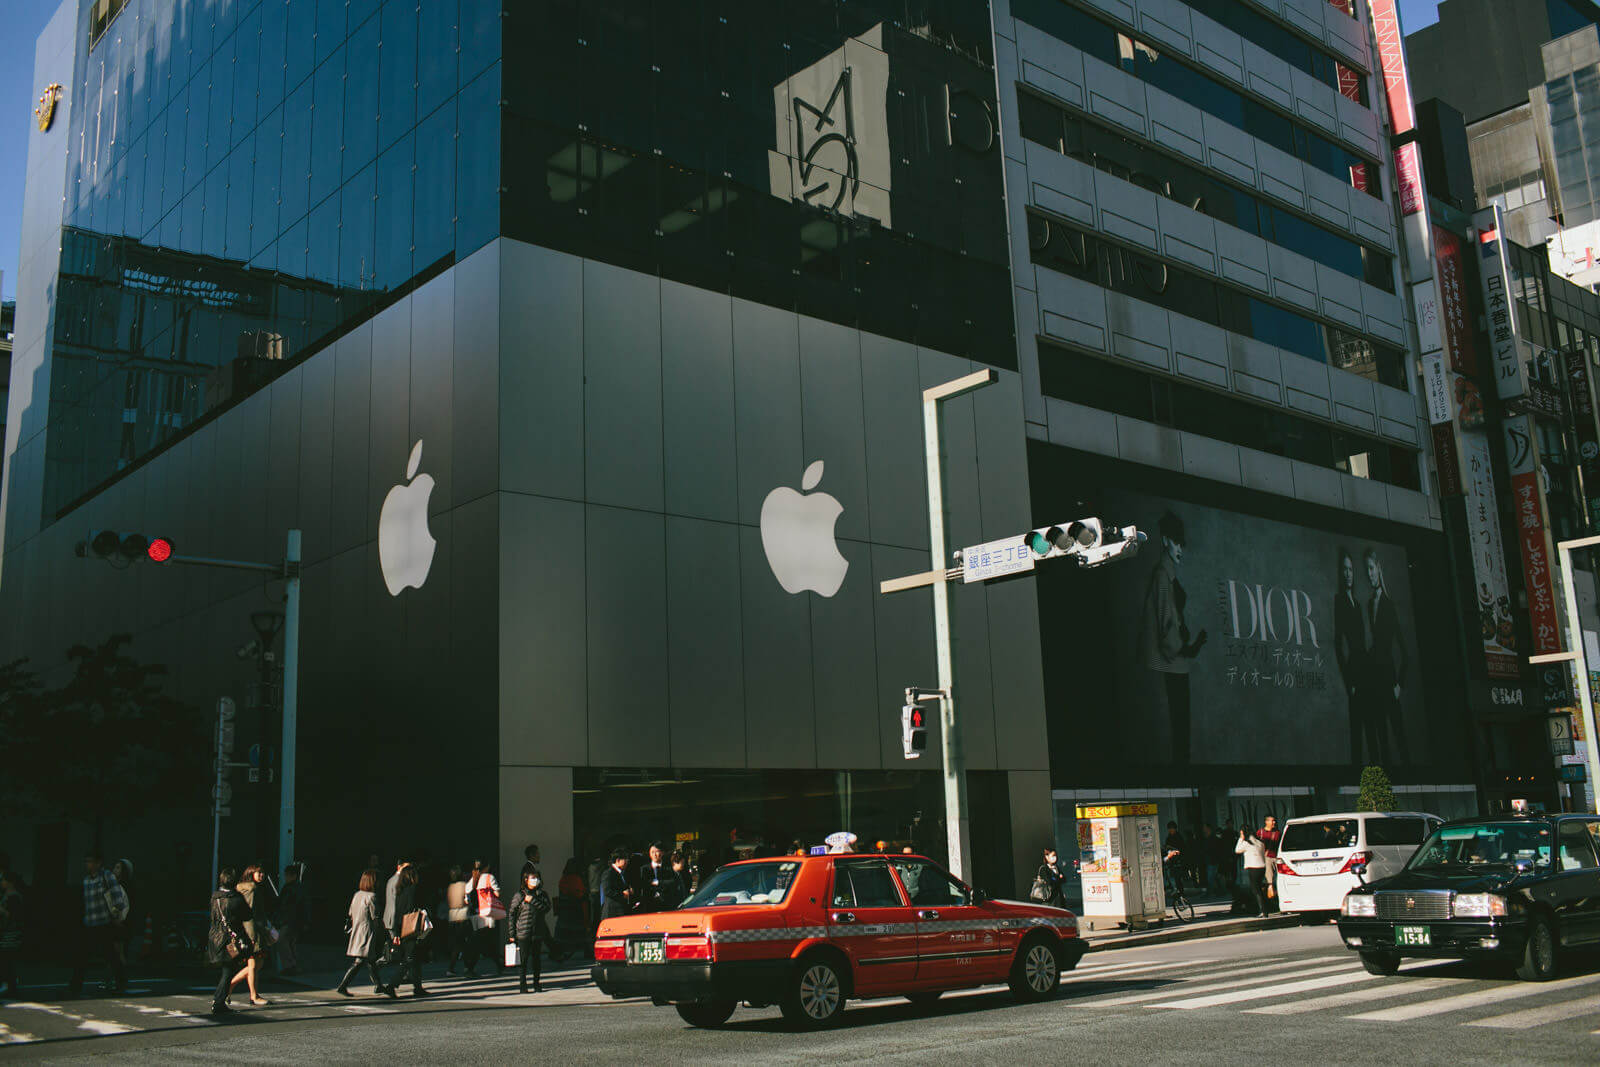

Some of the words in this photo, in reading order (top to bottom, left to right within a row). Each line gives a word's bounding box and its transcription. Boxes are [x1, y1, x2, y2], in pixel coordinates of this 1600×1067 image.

[1471, 454, 1494, 574] かにまつり
[968, 544, 1028, 570] 銀座三丁目
[1228, 579, 1321, 649] DIOR
[1403, 933, 1430, 945] 15-84
[955, 957, 972, 965] TAXI
